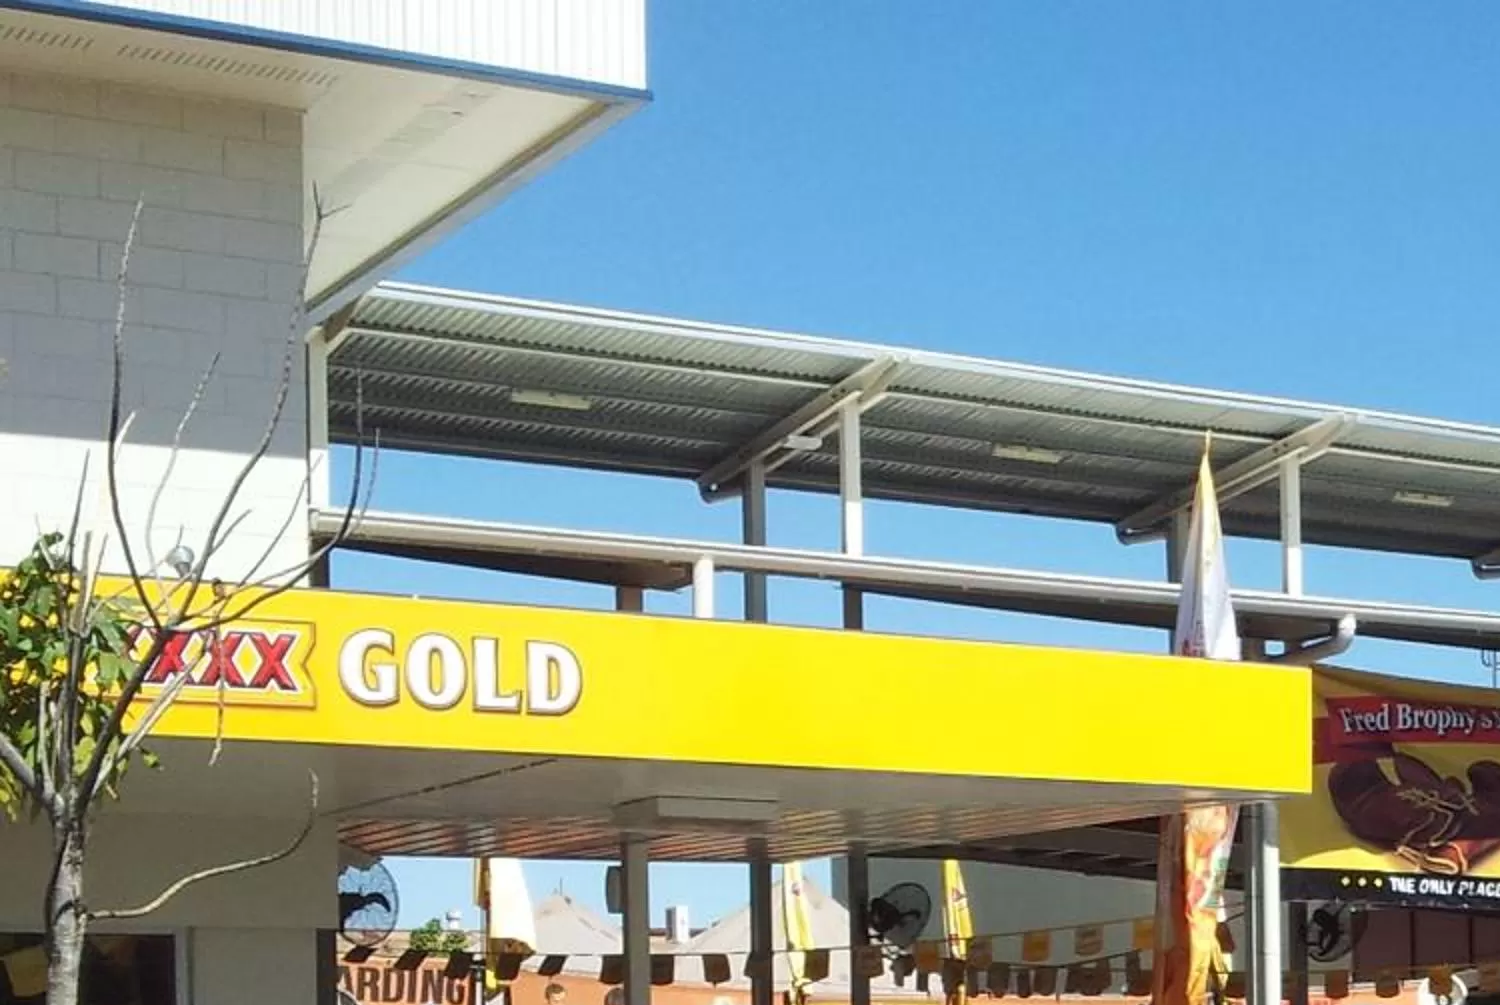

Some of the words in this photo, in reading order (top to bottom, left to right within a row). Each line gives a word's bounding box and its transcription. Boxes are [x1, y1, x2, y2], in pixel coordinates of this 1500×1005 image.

[122, 621, 298, 691] XXX
[338, 627, 583, 717] GOLD
[1339, 703, 1390, 733] Fred
[1395, 703, 1493, 735] Brophy's
[1388, 875, 1416, 894] THE
[1418, 877, 1456, 896] ONLY
